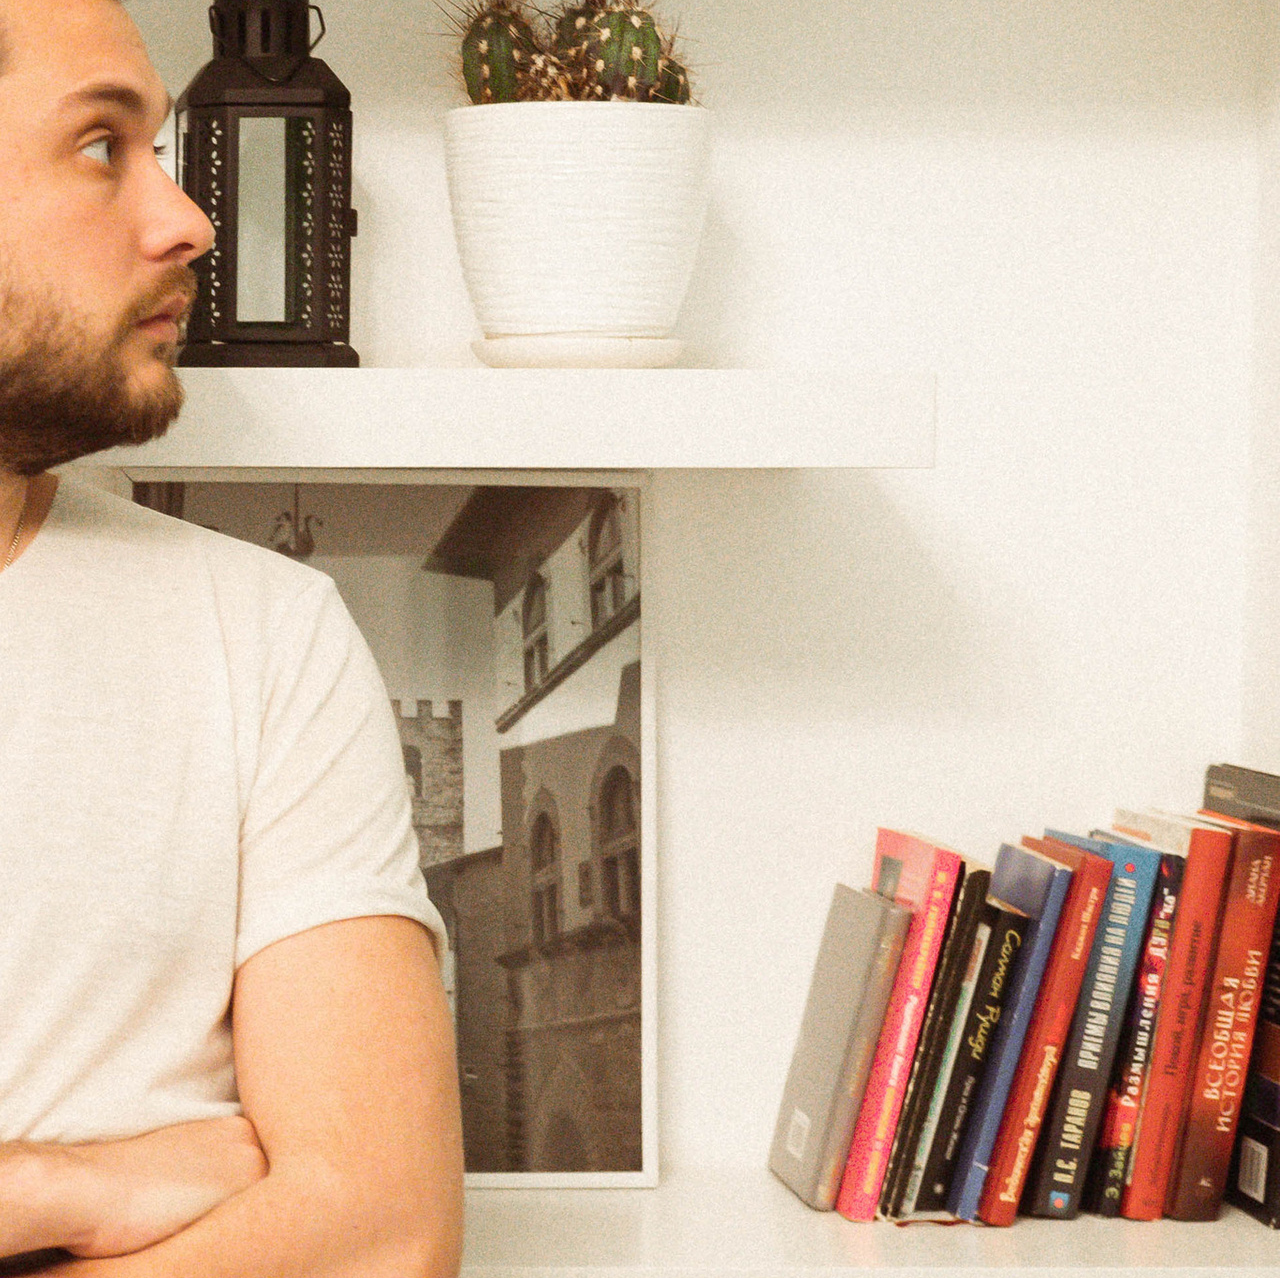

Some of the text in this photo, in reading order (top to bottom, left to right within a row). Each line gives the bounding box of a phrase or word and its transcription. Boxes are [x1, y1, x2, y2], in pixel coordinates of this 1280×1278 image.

[1089, 945, 1122, 1010] ВЛИЯНИЯ
[1103, 926, 1126, 945] НА
[966, 928, 1022, 1061] Салман Рушди
[1076, 1010, 1108, 1069] ПРИЕМЫ
[1121, 972, 1159, 1108] Размышления
[1202, 975, 1240, 1100] ВСЕОБЩАЯ
[1215, 948, 1262, 1132] ИСТОРИЯ ЛЮБВИ
[1059, 1088, 1092, 1151] ТАРАНОВ
